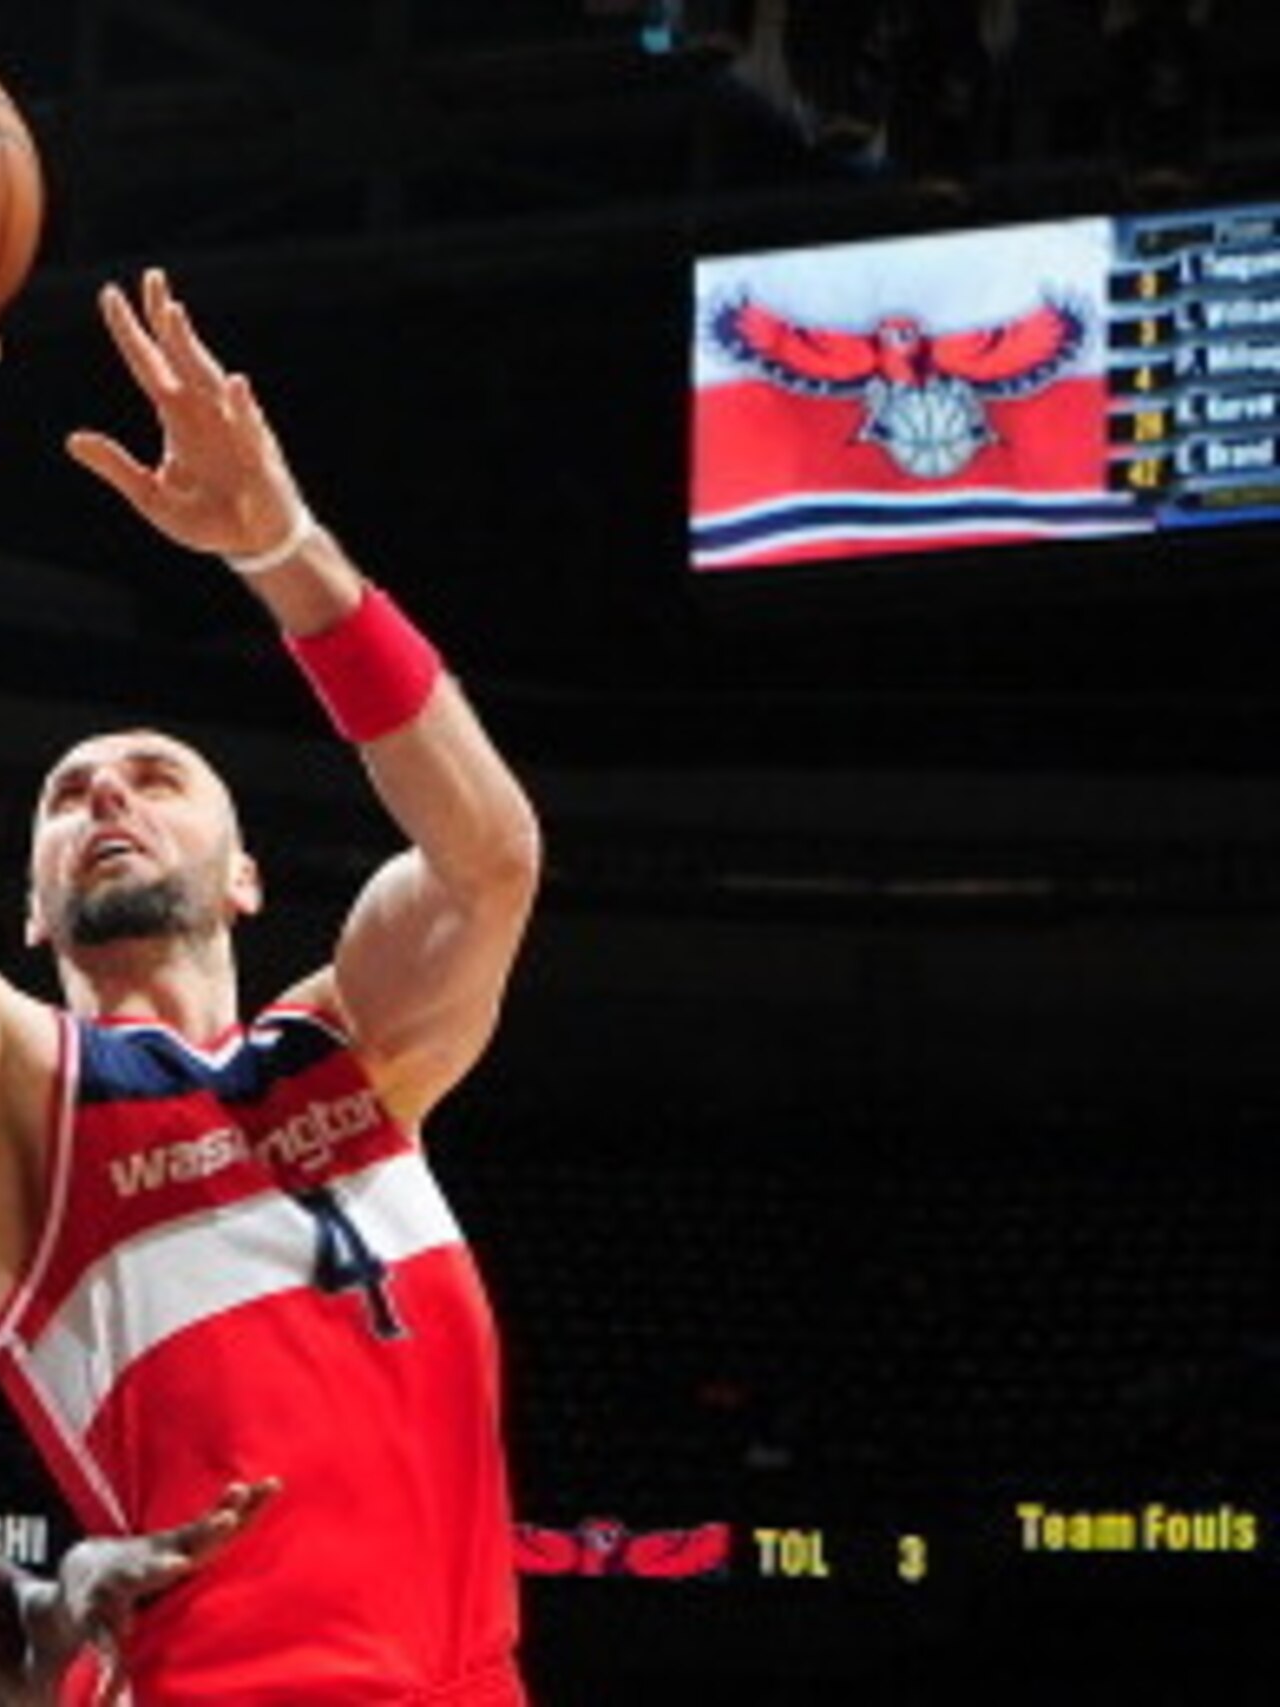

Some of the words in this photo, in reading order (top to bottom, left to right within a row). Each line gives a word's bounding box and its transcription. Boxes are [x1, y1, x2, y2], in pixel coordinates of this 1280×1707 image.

[298, 1190, 412, 1340] 4
[1018, 1503, 1136, 1551] Team
[1144, 1503, 1257, 1551] Fouls
[755, 1529, 828, 1578] TOL
[899, 1535, 926, 1582] 3
